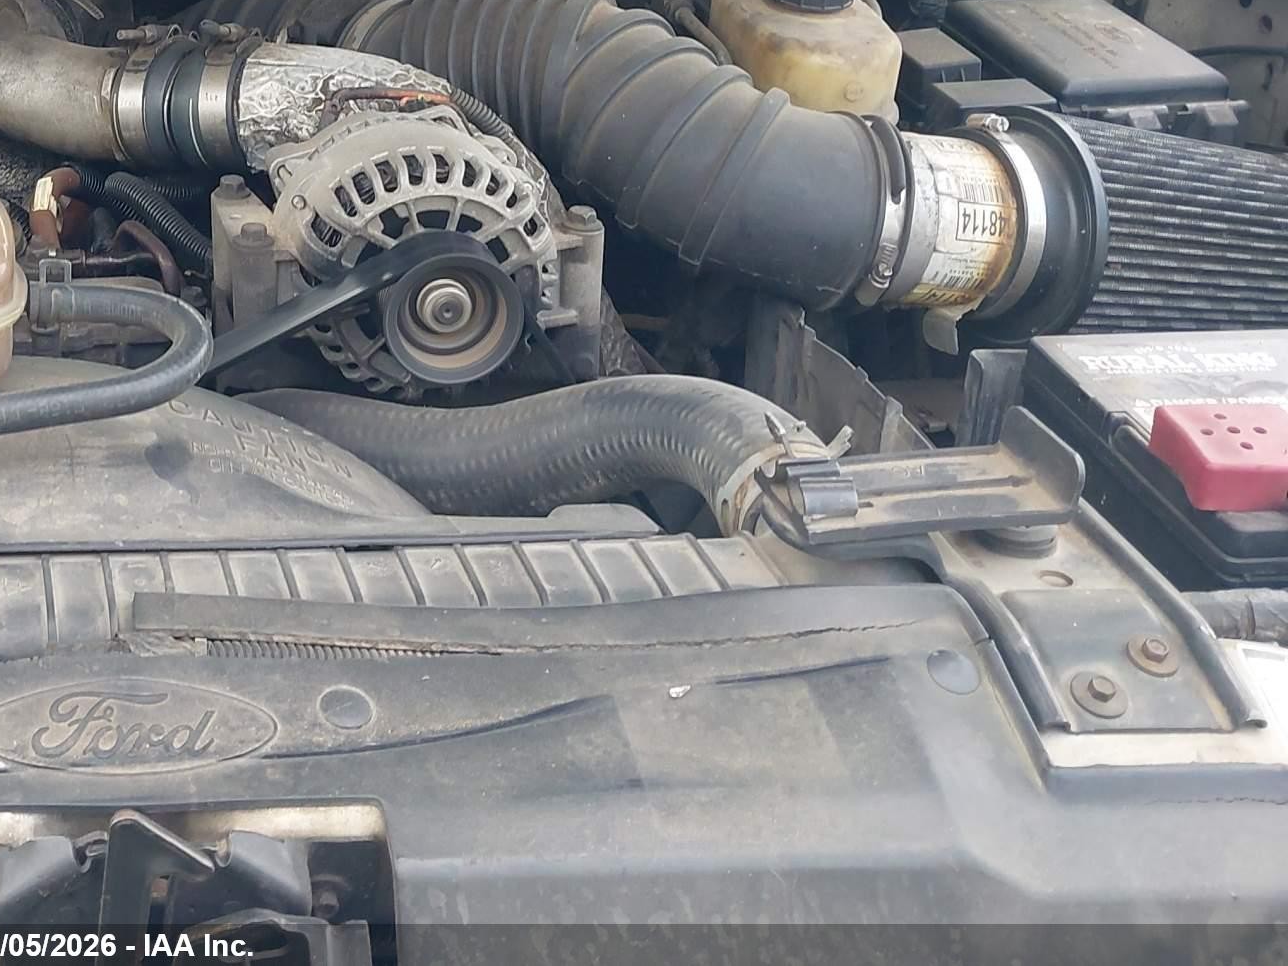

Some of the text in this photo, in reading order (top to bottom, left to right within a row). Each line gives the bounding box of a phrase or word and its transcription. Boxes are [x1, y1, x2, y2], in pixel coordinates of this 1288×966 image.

[962, 208, 1008, 238] 48114
[1078, 353, 1196, 371] RURAL
[167, 399, 352, 479] CAUTION
[235, 434, 308, 473] FAN
[31, 690, 216, 759] Ford
